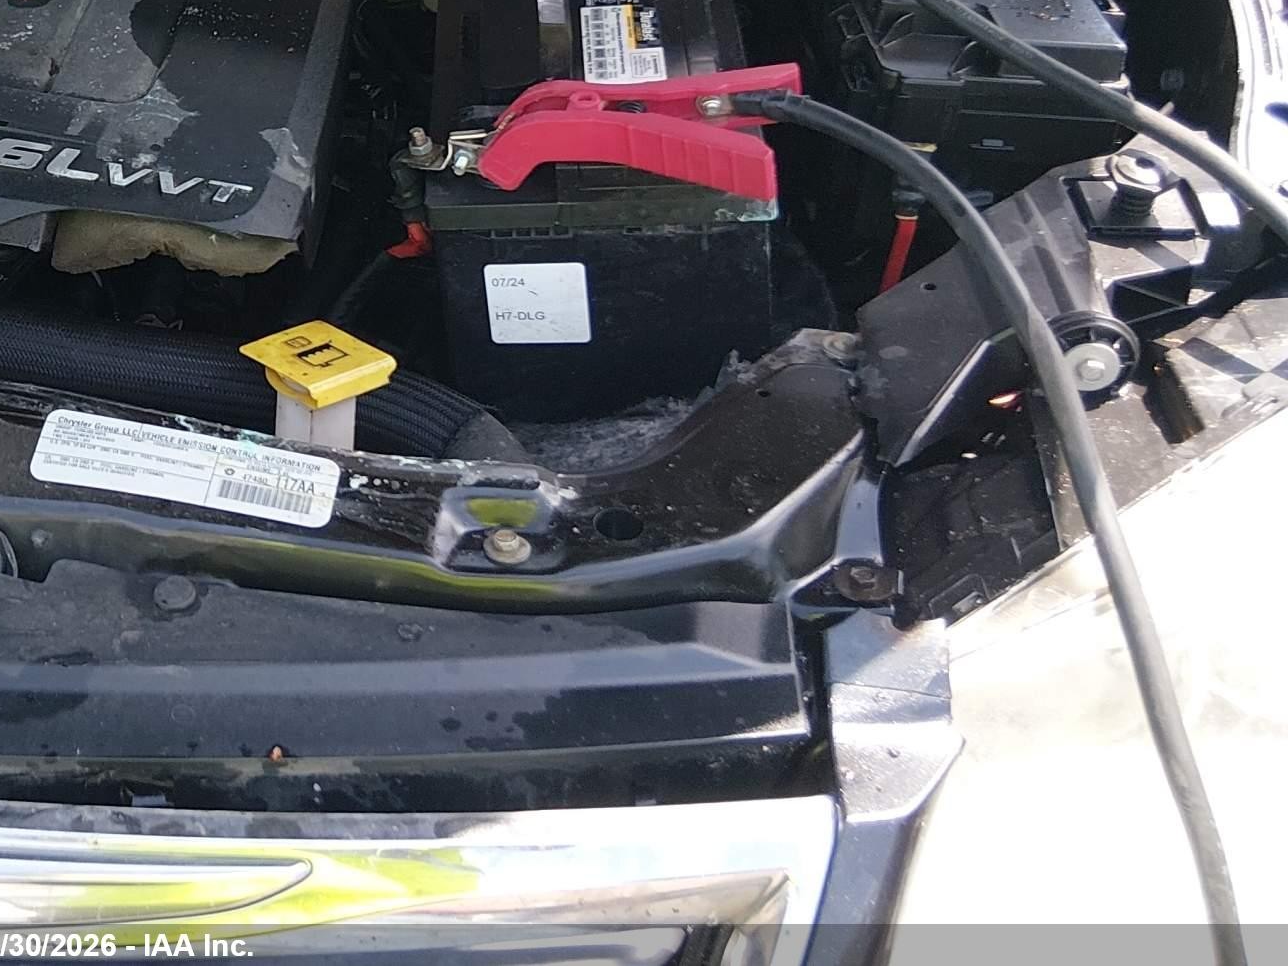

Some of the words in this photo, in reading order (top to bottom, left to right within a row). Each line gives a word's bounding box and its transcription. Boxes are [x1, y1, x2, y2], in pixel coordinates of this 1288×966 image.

[107, 161, 254, 203] VVT
[491, 277, 525, 287] 07/24
[495, 310, 545, 321] H7-DLG
[58, 416, 92, 429] Chrysler
[94, 422, 120, 435] Group
[122, 427, 139, 439] LLC
[141, 430, 175, 444] VEHICLE
[177, 437, 217, 452] EMISSION
[220, 446, 258, 461] CONTROL
[261, 455, 322, 472] INFORMATION
